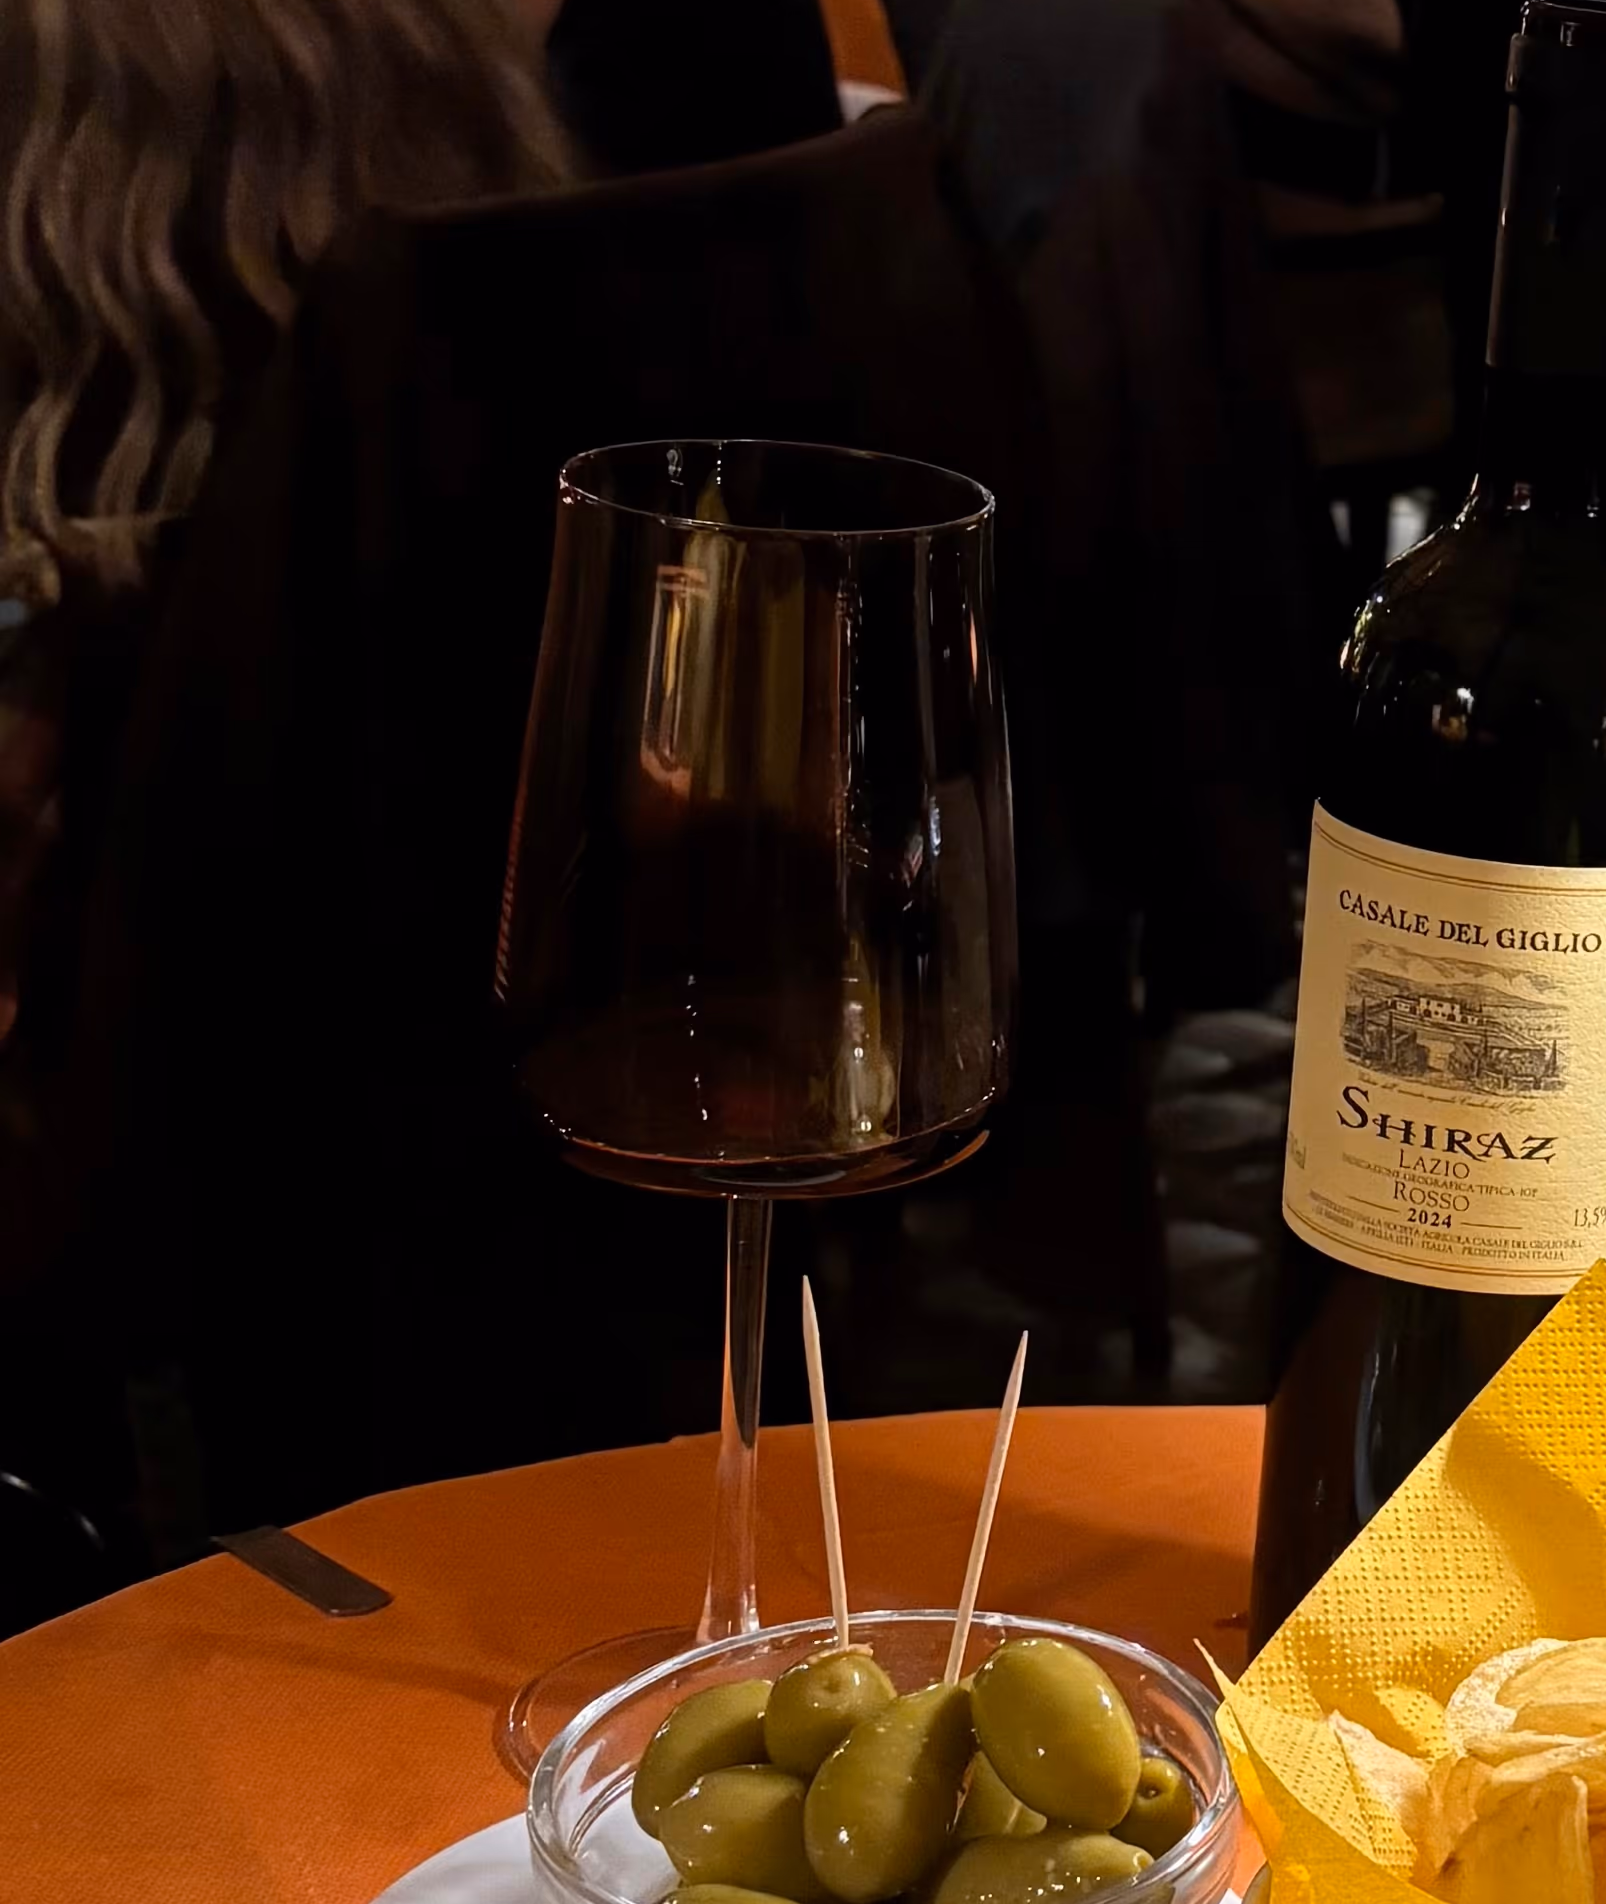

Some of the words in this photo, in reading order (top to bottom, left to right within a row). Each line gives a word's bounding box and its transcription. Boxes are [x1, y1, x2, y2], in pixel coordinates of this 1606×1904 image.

[1339, 889, 1430, 937] CASALE
[1438, 919, 1489, 947] DEL
[1496, 928, 1603, 954] GIGLIO
[1399, 1148, 1470, 1180] LAZIO
[1393, 1180, 1470, 1212] ROSSO
[1407, 1207, 1452, 1229] 2024
